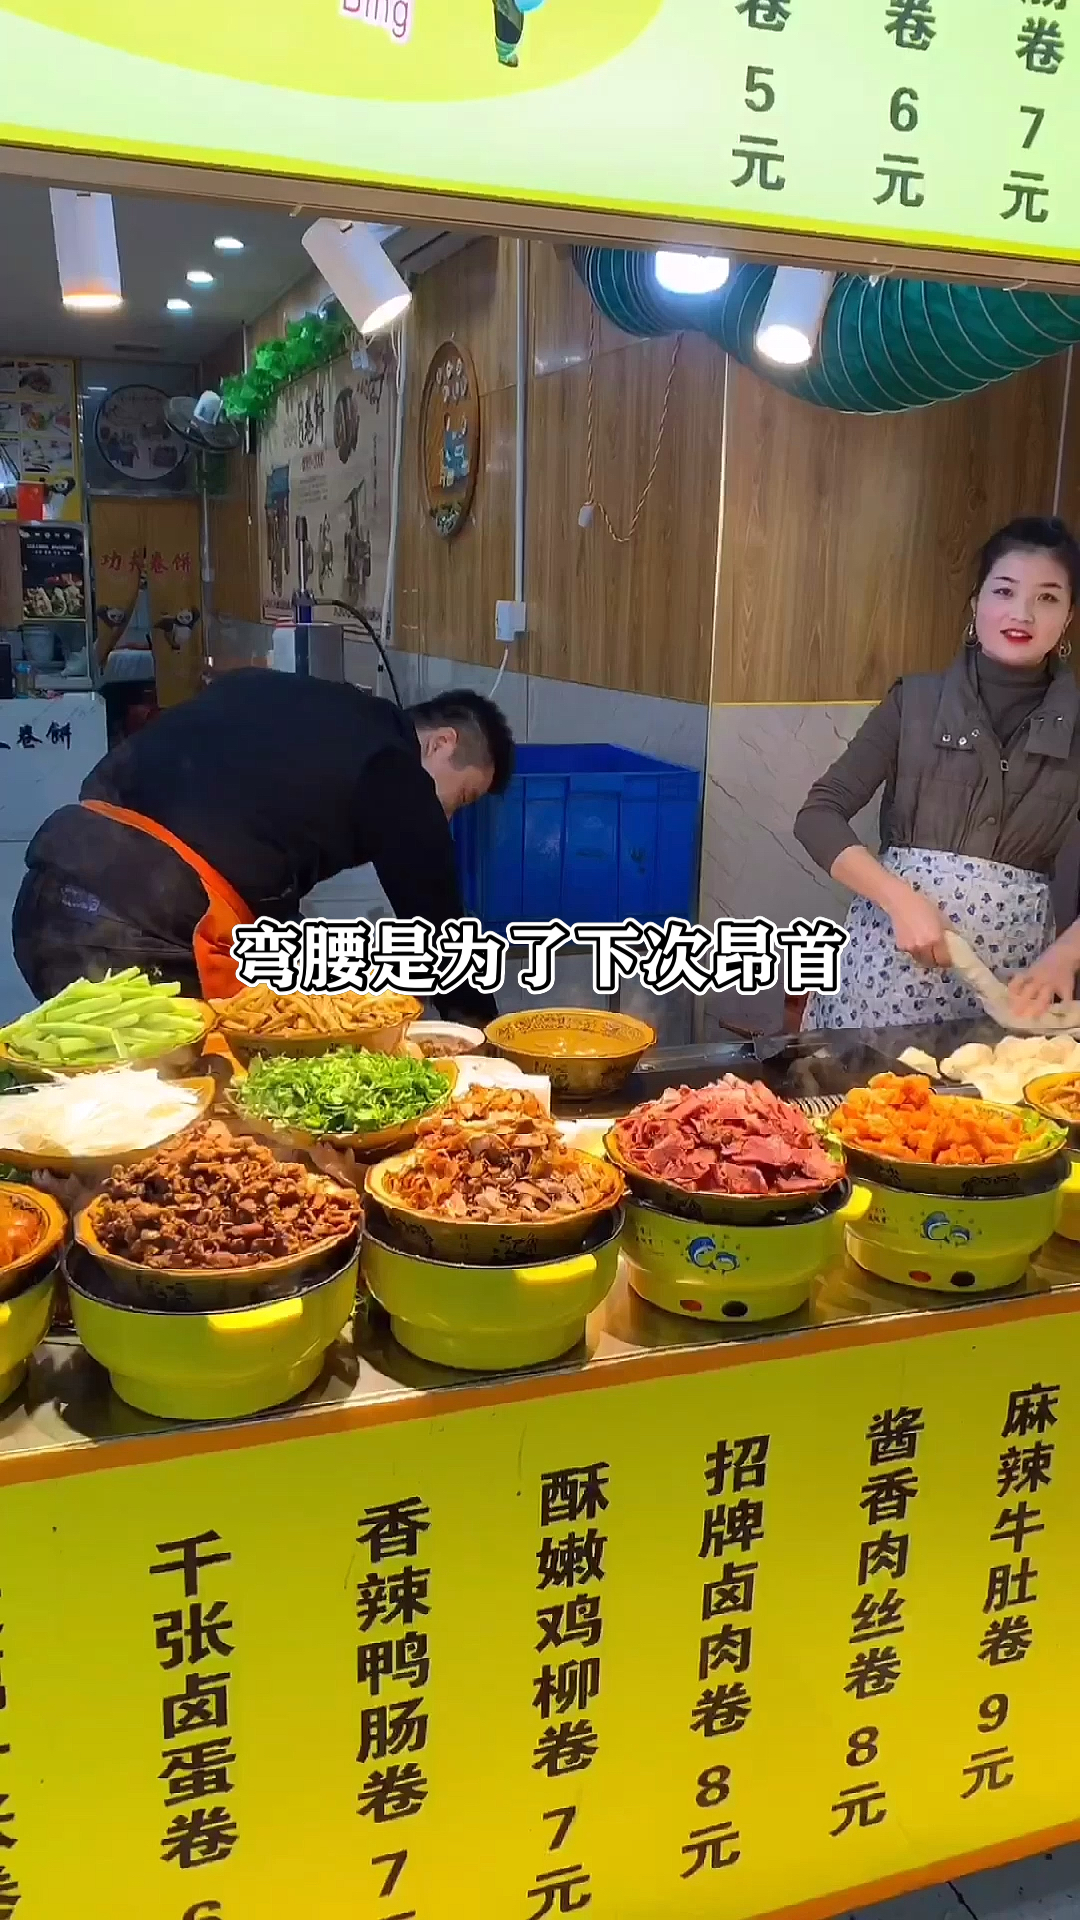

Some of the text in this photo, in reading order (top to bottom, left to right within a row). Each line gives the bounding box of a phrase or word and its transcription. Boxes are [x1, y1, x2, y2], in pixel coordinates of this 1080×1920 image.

[731, 65, 786, 191] 5元
[873, 86, 925, 208] 6元
[999, 0, 1068, 224] 卷 7元
[149, 1529, 239, 1869] 千张卤蛋卷
[355, 1496, 432, 1920] 香辣鸭肠卷 7
[527, 1461, 611, 1920] 酥嫩鸡柳卷 7元
[680, 1434, 771, 1878] 招牌卤肉卷 8元
[829, 1406, 925, 1838] 酱香肉丝卷 8元
[960, 1382, 1061, 1800] 麻辣牛肚卷 9元
